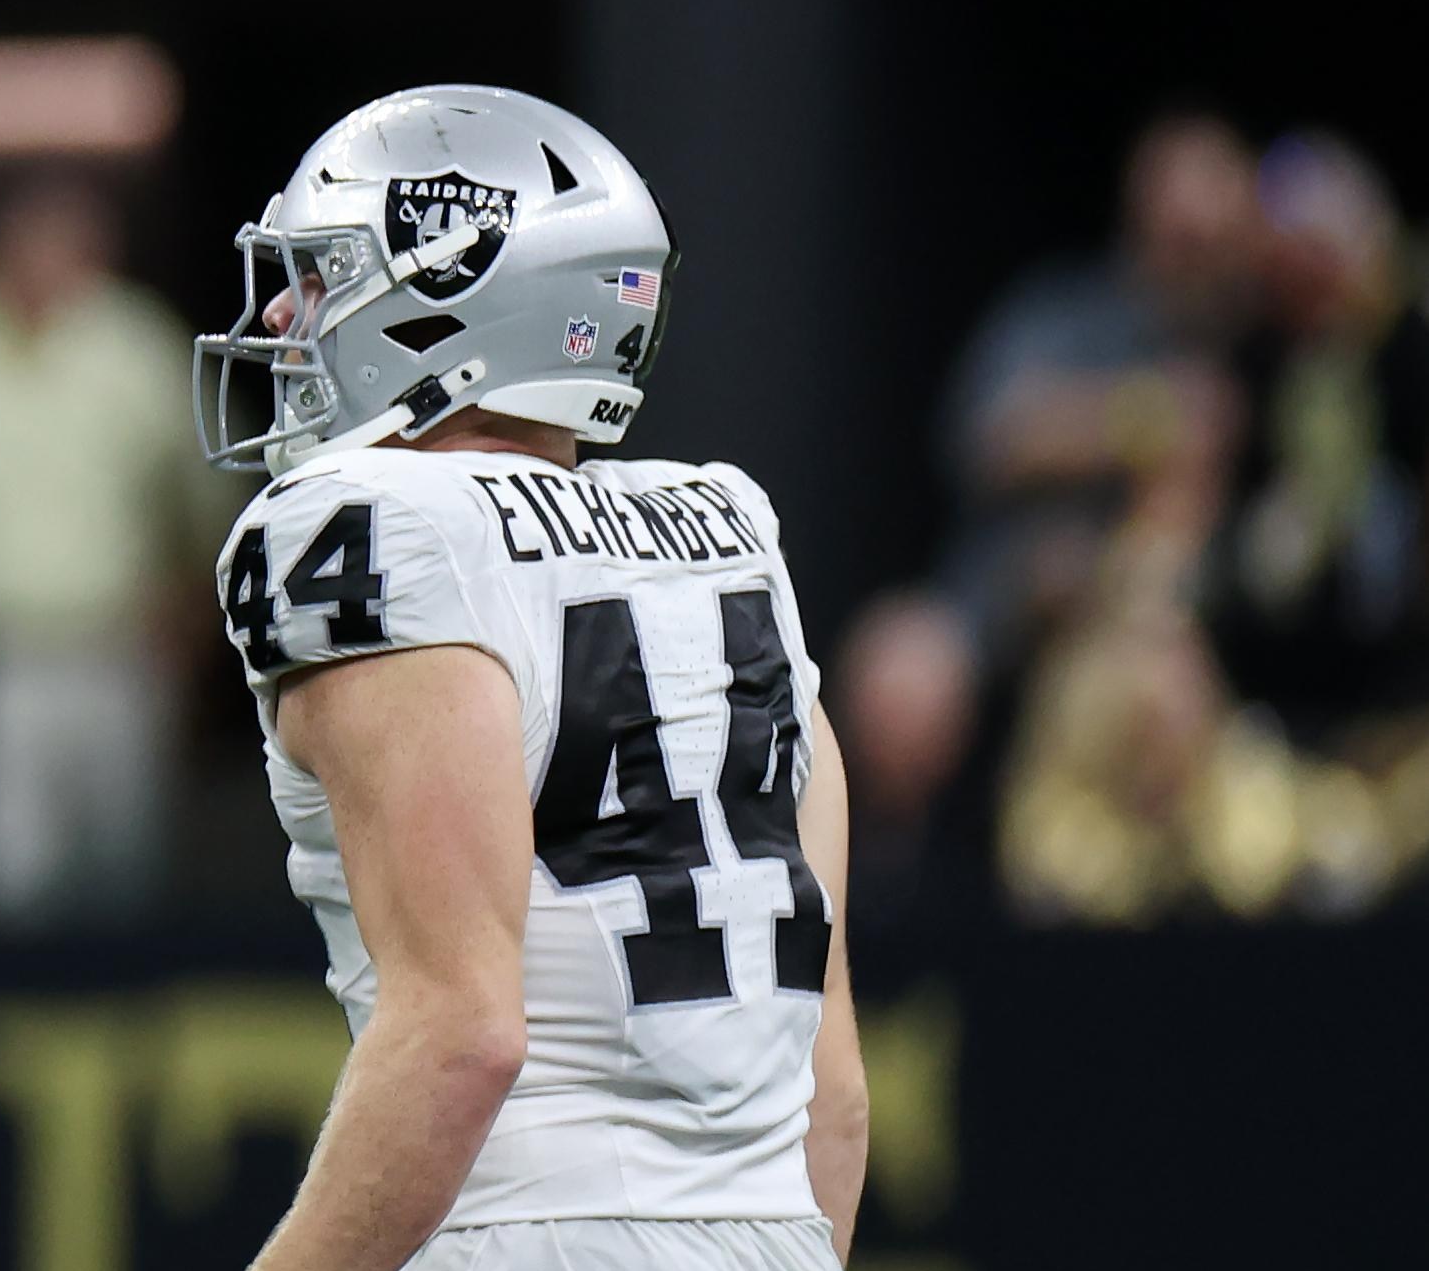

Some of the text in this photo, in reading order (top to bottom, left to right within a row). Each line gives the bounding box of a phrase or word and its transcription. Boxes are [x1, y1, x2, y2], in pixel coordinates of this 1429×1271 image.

[398, 180, 504, 208] RAIDERS
[568, 335, 593, 355] NFL
[227, 504, 389, 672] 44
[531, 588, 833, 1007] 44
